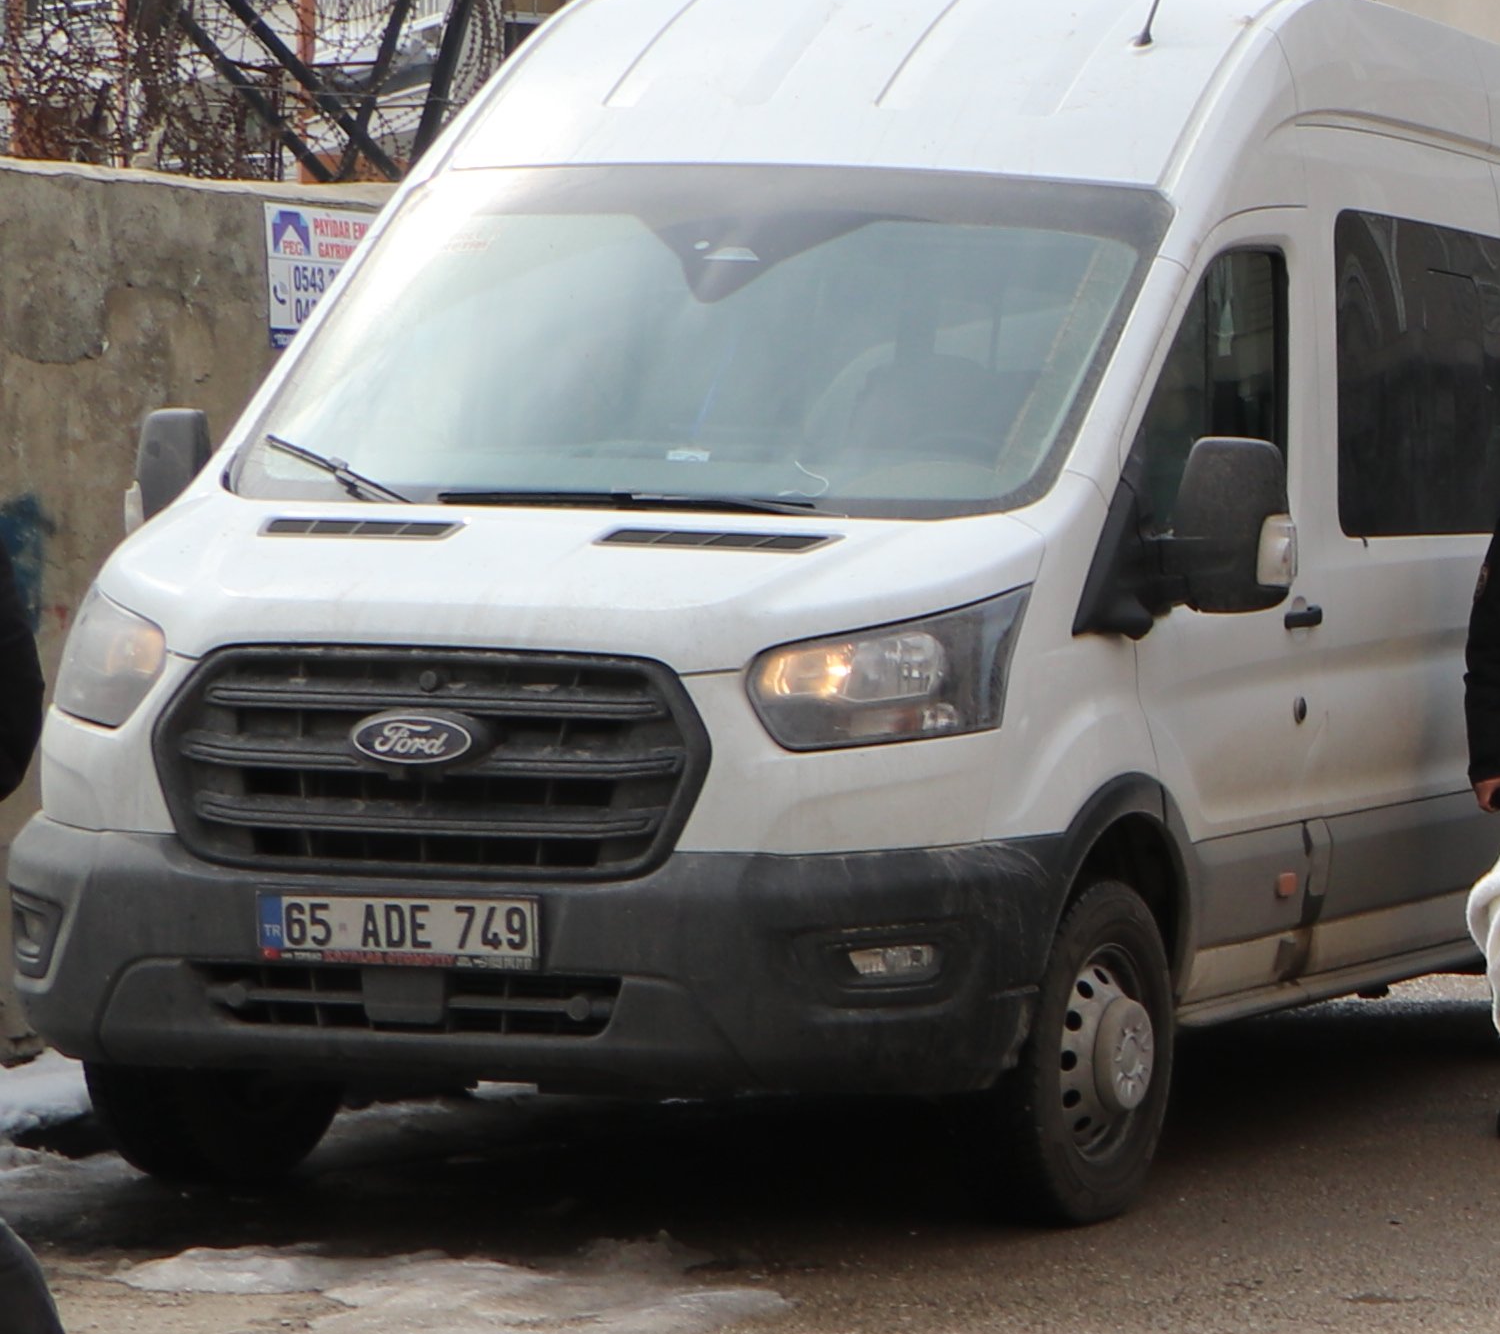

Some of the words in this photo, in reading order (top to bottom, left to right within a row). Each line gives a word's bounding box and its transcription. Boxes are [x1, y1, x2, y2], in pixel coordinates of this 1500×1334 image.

[282, 239, 304, 255] PEG
[293, 265, 325, 293] 0543
[374, 722, 449, 755] Ford
[264, 924, 281, 937] TR
[284, 902, 332, 947] 65
[361, 904, 432, 949] ADE
[455, 905, 528, 951] 749
